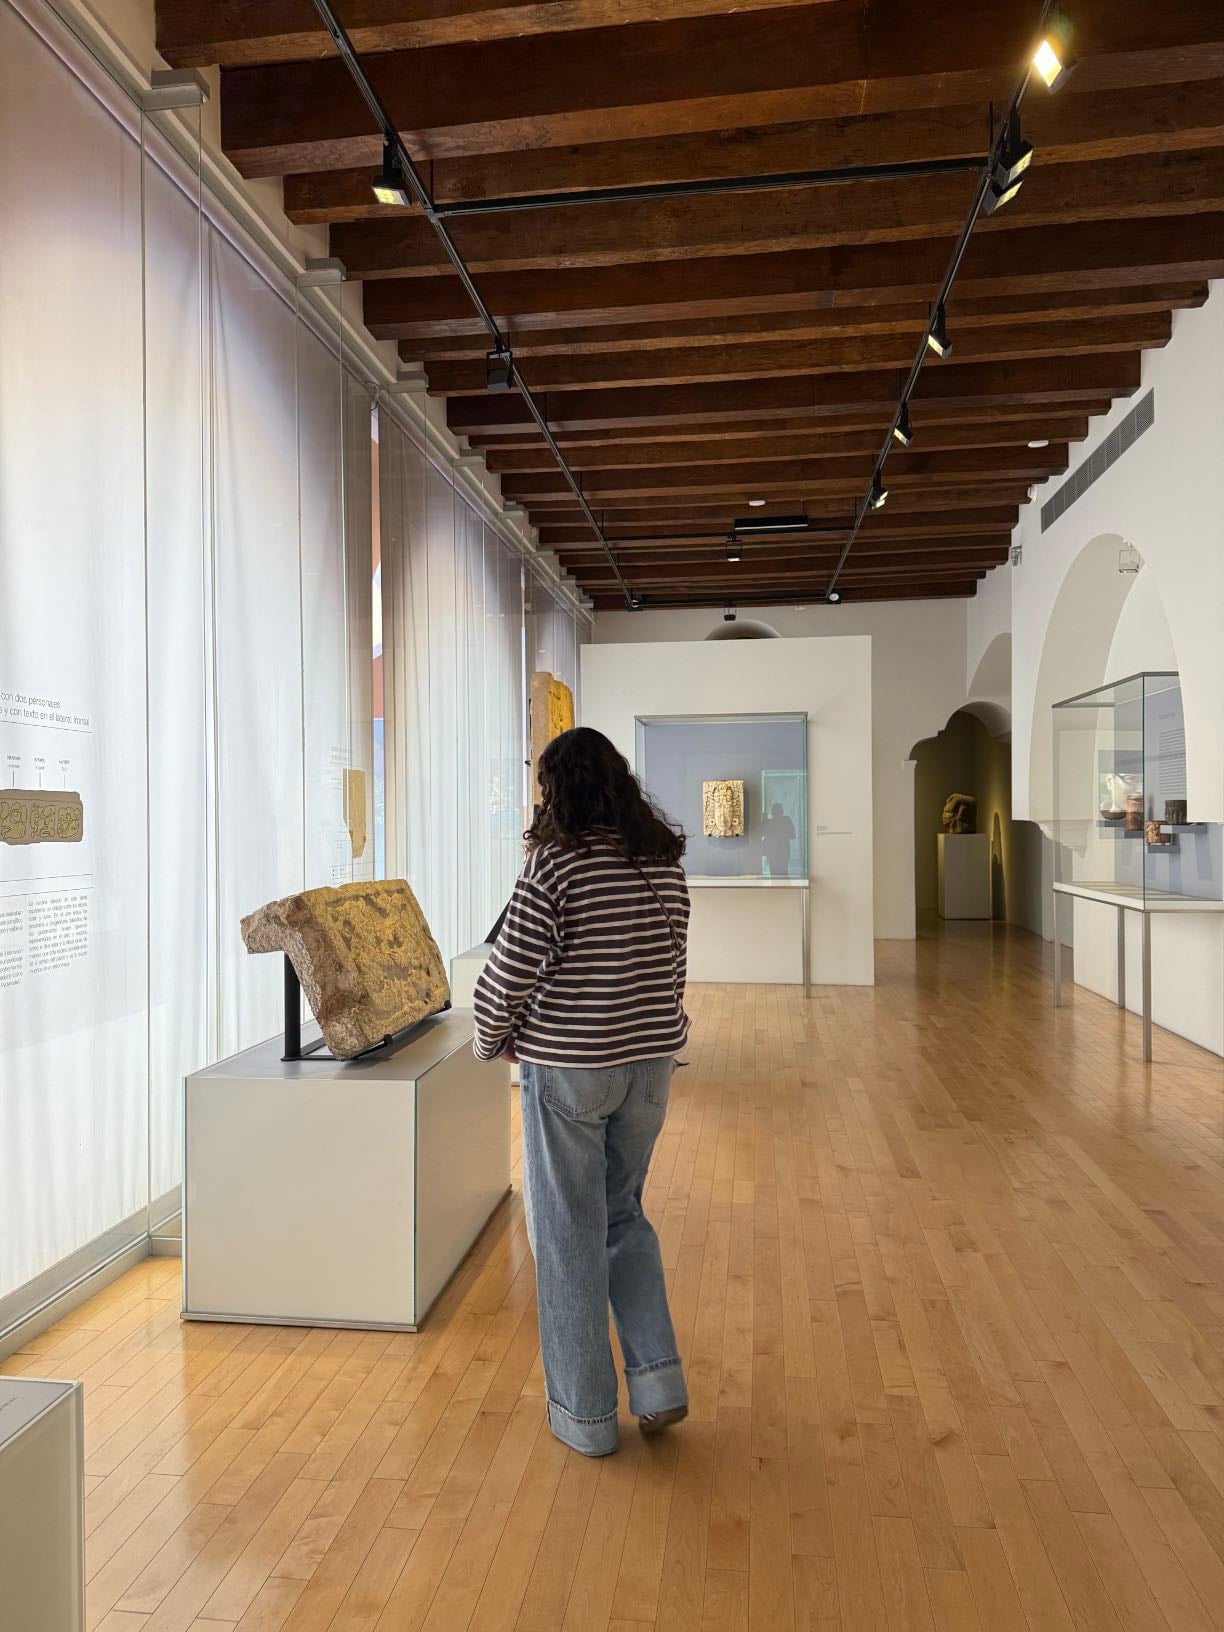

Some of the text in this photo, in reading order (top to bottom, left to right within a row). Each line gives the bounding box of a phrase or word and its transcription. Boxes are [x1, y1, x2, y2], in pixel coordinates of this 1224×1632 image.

[15, 693, 27, 704] dos
[4, 707, 9, 717] y
[10, 708, 22, 717] con
[40, 712, 48, 720] en
